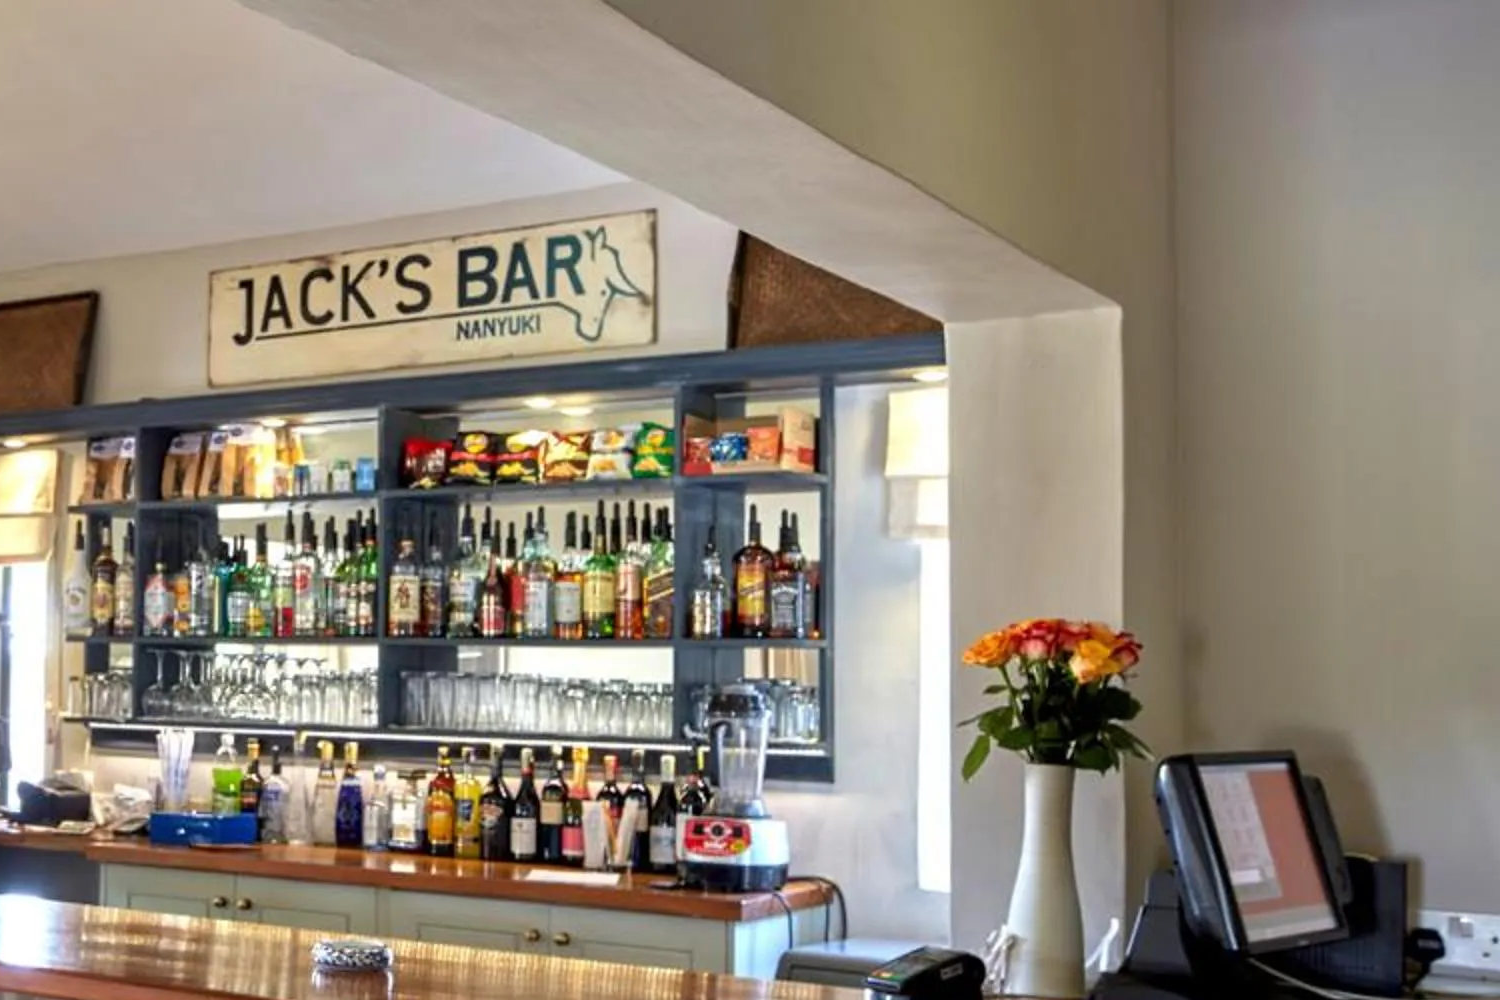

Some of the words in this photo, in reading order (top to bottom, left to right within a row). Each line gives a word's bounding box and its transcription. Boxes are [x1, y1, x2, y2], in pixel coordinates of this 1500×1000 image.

[233, 253, 432, 345] JACK'S
[458, 234, 586, 308] BAR
[456, 313, 542, 341] NANYUKI
